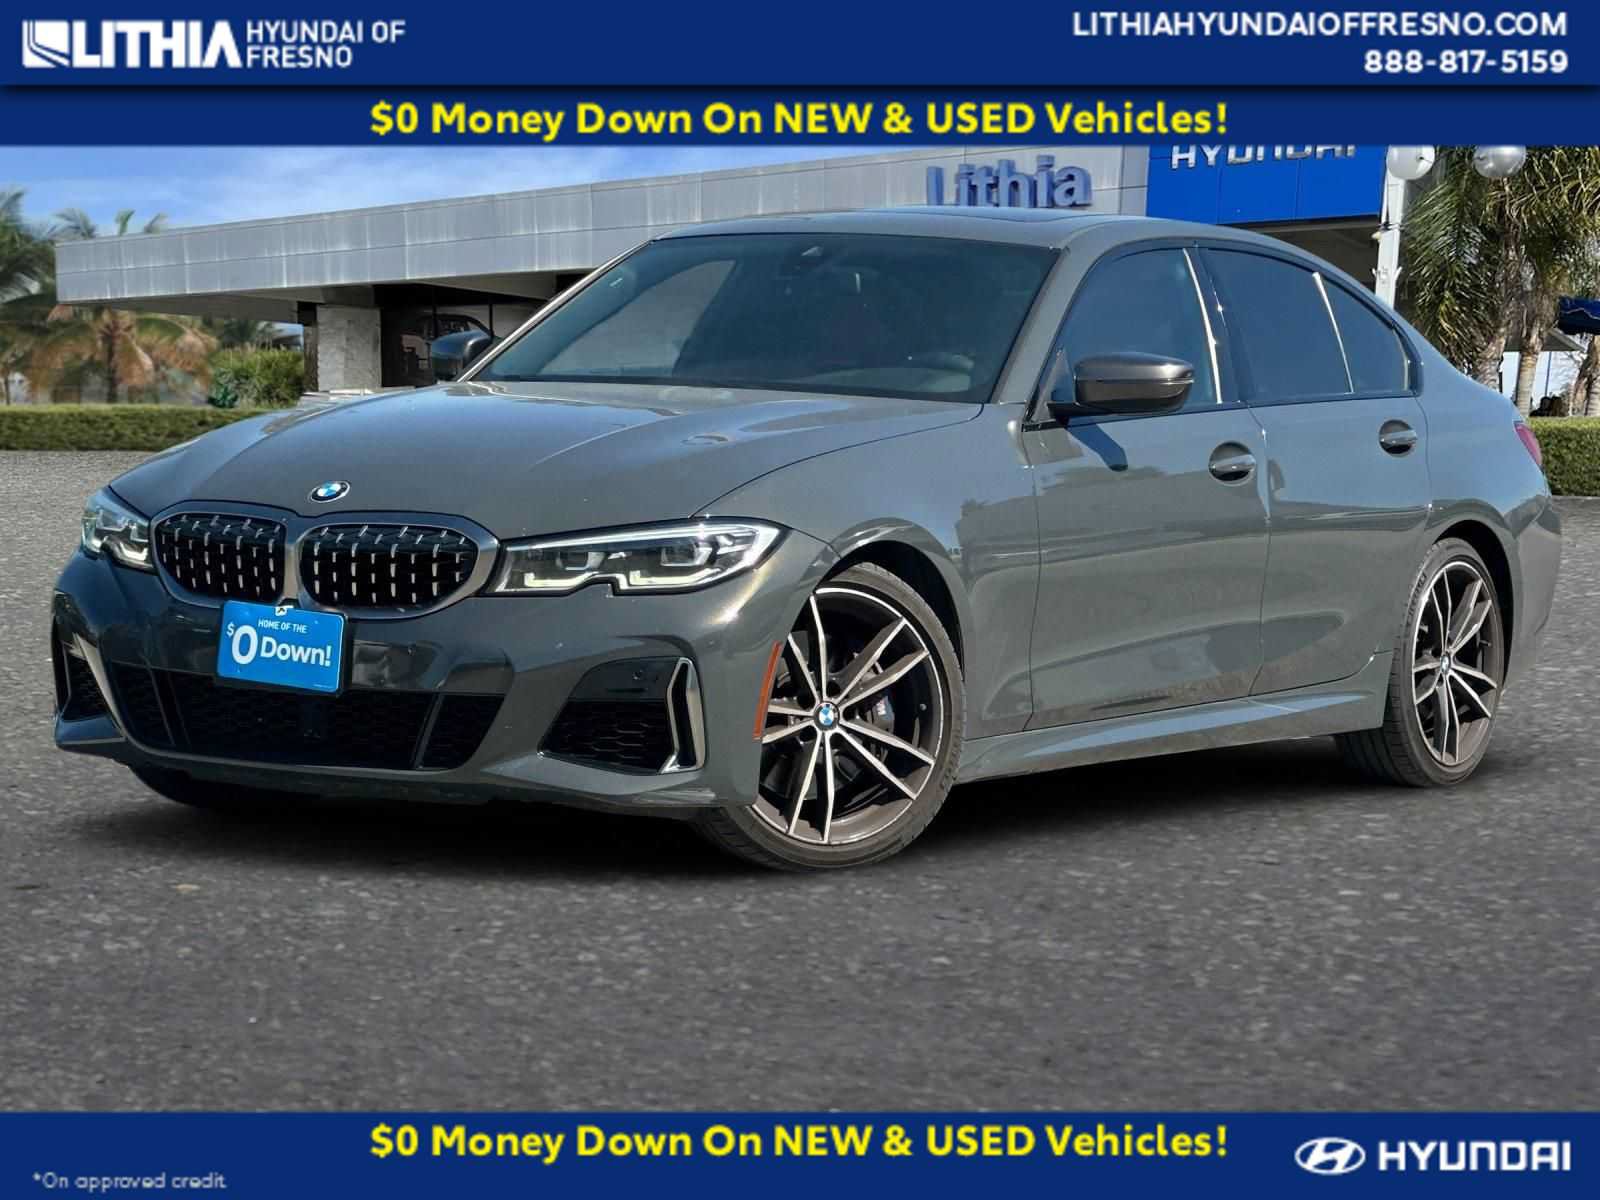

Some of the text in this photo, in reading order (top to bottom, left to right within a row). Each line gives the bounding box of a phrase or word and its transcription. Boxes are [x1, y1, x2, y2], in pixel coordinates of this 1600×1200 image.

[926, 154, 1092, 208] Lithia
[258, 619, 308, 633] HOME OF THE
[260, 636, 332, 667] Down!
